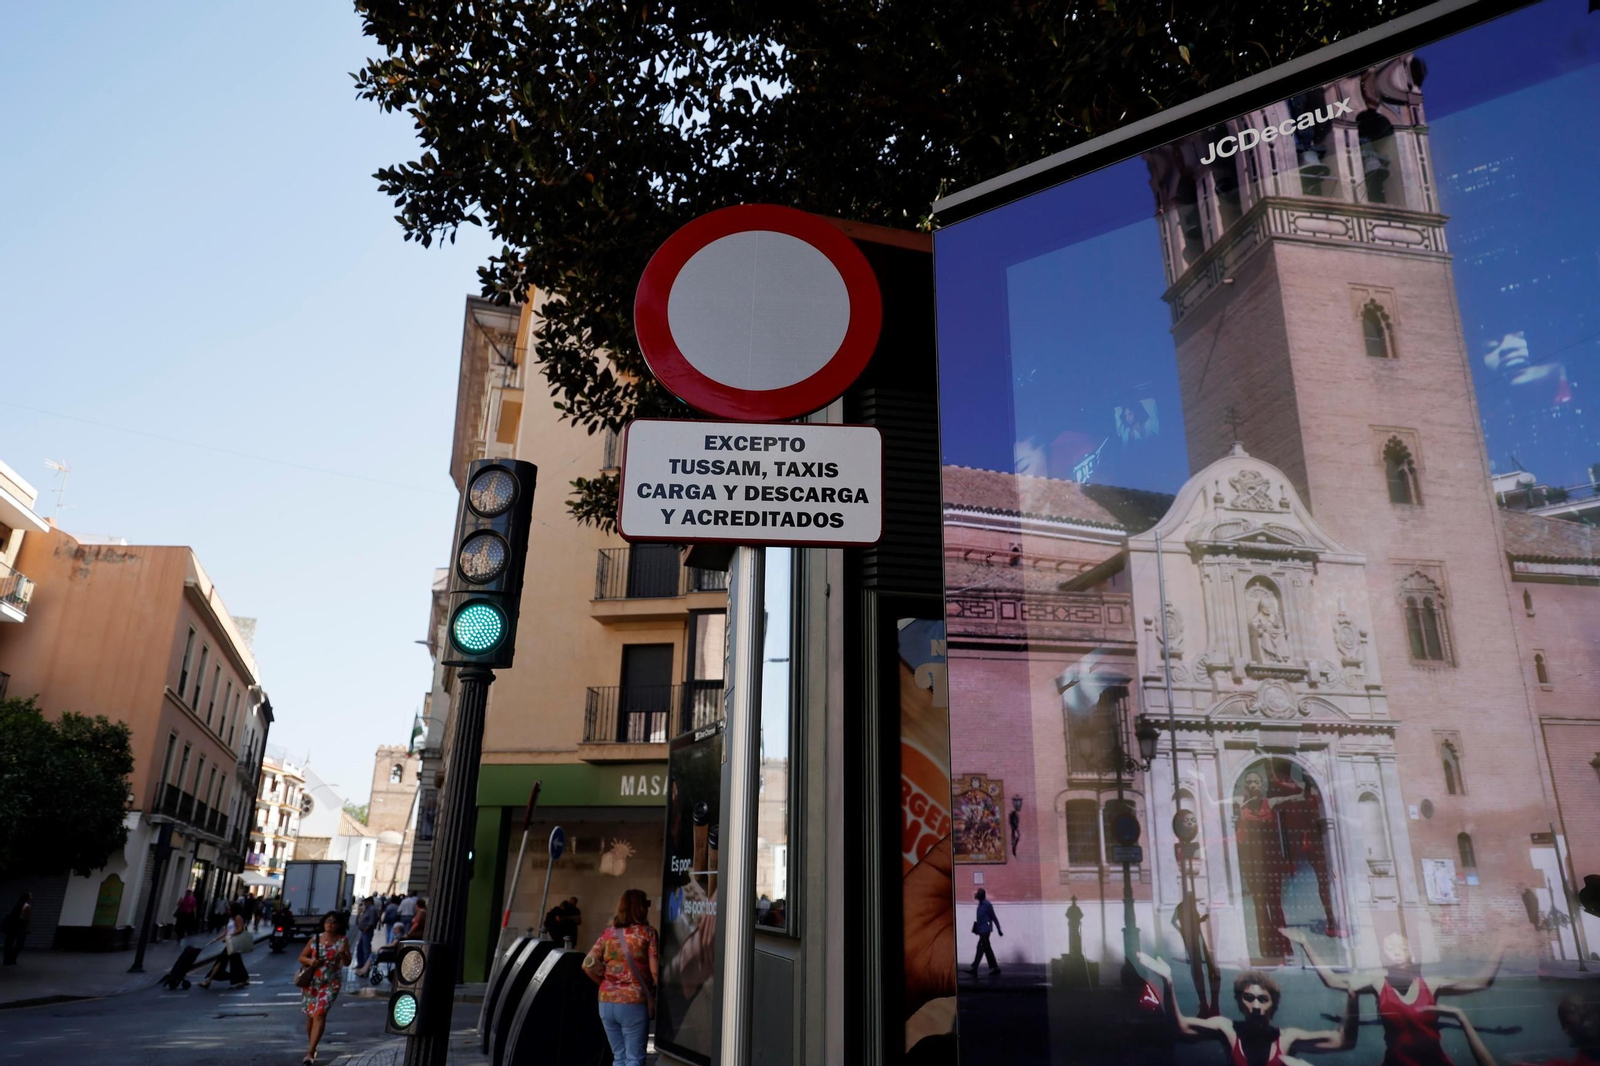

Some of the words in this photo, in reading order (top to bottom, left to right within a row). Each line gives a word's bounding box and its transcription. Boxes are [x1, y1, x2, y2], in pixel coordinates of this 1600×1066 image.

[1200, 97, 1353, 165] JCDecaux
[704, 435, 806, 453] EXCEPTO
[669, 458, 768, 480] TUSSAM,
[774, 461, 839, 478] TAXIS
[636, 482, 717, 500] CARGA
[723, 485, 738, 501] Y
[744, 485, 869, 504] DESCARGA
[660, 508, 676, 525] Y
[681, 509, 845, 529] ACREDITADOS
[671, 855, 679, 872] Es
[678, 858, 691, 876] por
[684, 900, 692, 914] es
[691, 901, 705, 919] por
